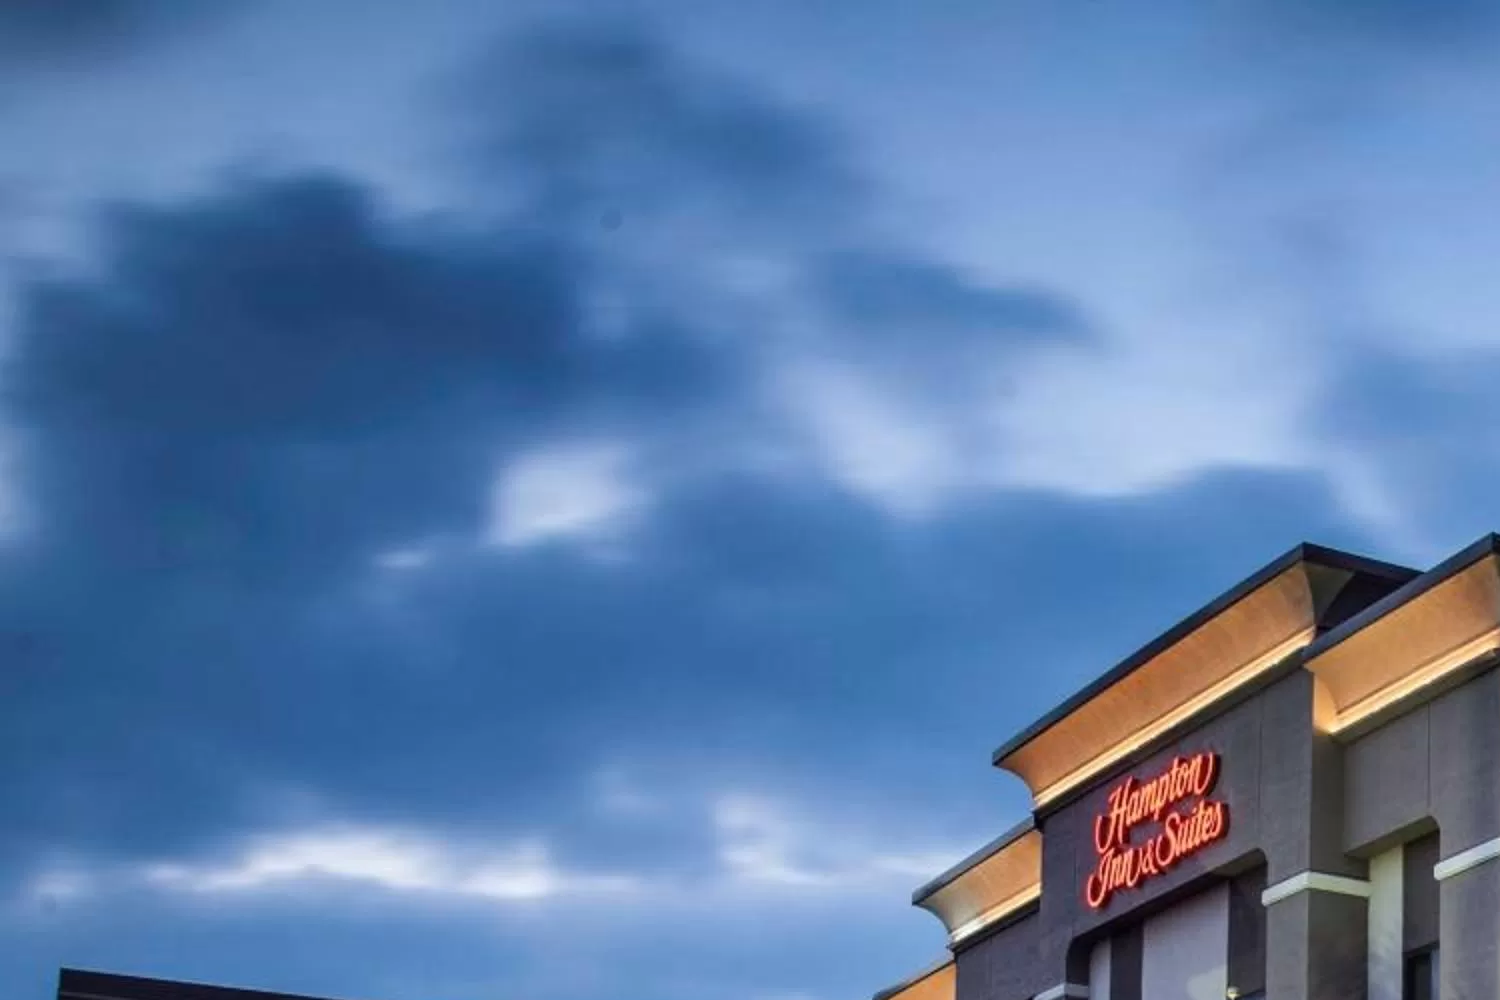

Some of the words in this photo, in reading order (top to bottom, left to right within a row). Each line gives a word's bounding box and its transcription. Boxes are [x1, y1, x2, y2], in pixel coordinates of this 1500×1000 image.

[1087, 847, 1143, 907] Inn
[1143, 839, 1159, 875] &
[1155, 799, 1223, 866] Suites
[1095, 751, 1215, 854] Hampton
